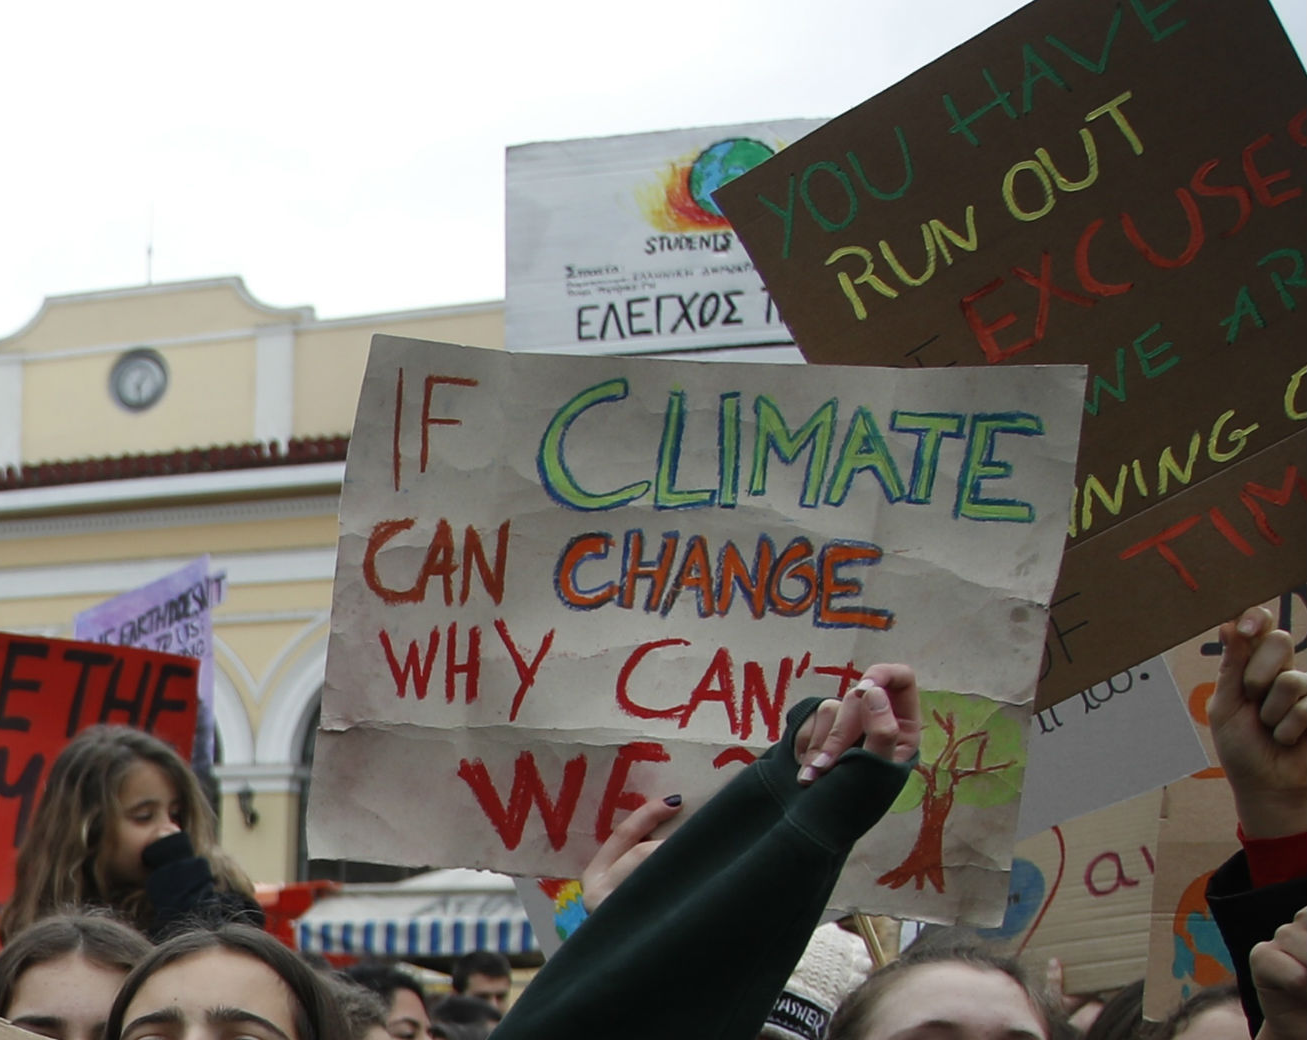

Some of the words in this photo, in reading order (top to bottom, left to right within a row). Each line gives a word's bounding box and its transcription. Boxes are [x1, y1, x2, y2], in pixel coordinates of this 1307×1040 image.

[757, 126, 915, 258] YOU
[943, 0, 1187, 147] HAVE
[825, 205, 979, 320] RUN
[1001, 91, 1144, 220] OUT
[577, 291, 745, 342] ΕΛΕΓΧΟΣ
[1220, 248, 1307, 345] AR
[393, 367, 478, 491] IF
[536, 377, 1044, 523] CLIMATE
[362, 517, 511, 606] CAN
[554, 527, 896, 631] CHANGE
[379, 619, 555, 721] WHY
[615, 637, 863, 742] CAN'T
[773, 999, 825, 1038] ASHER
